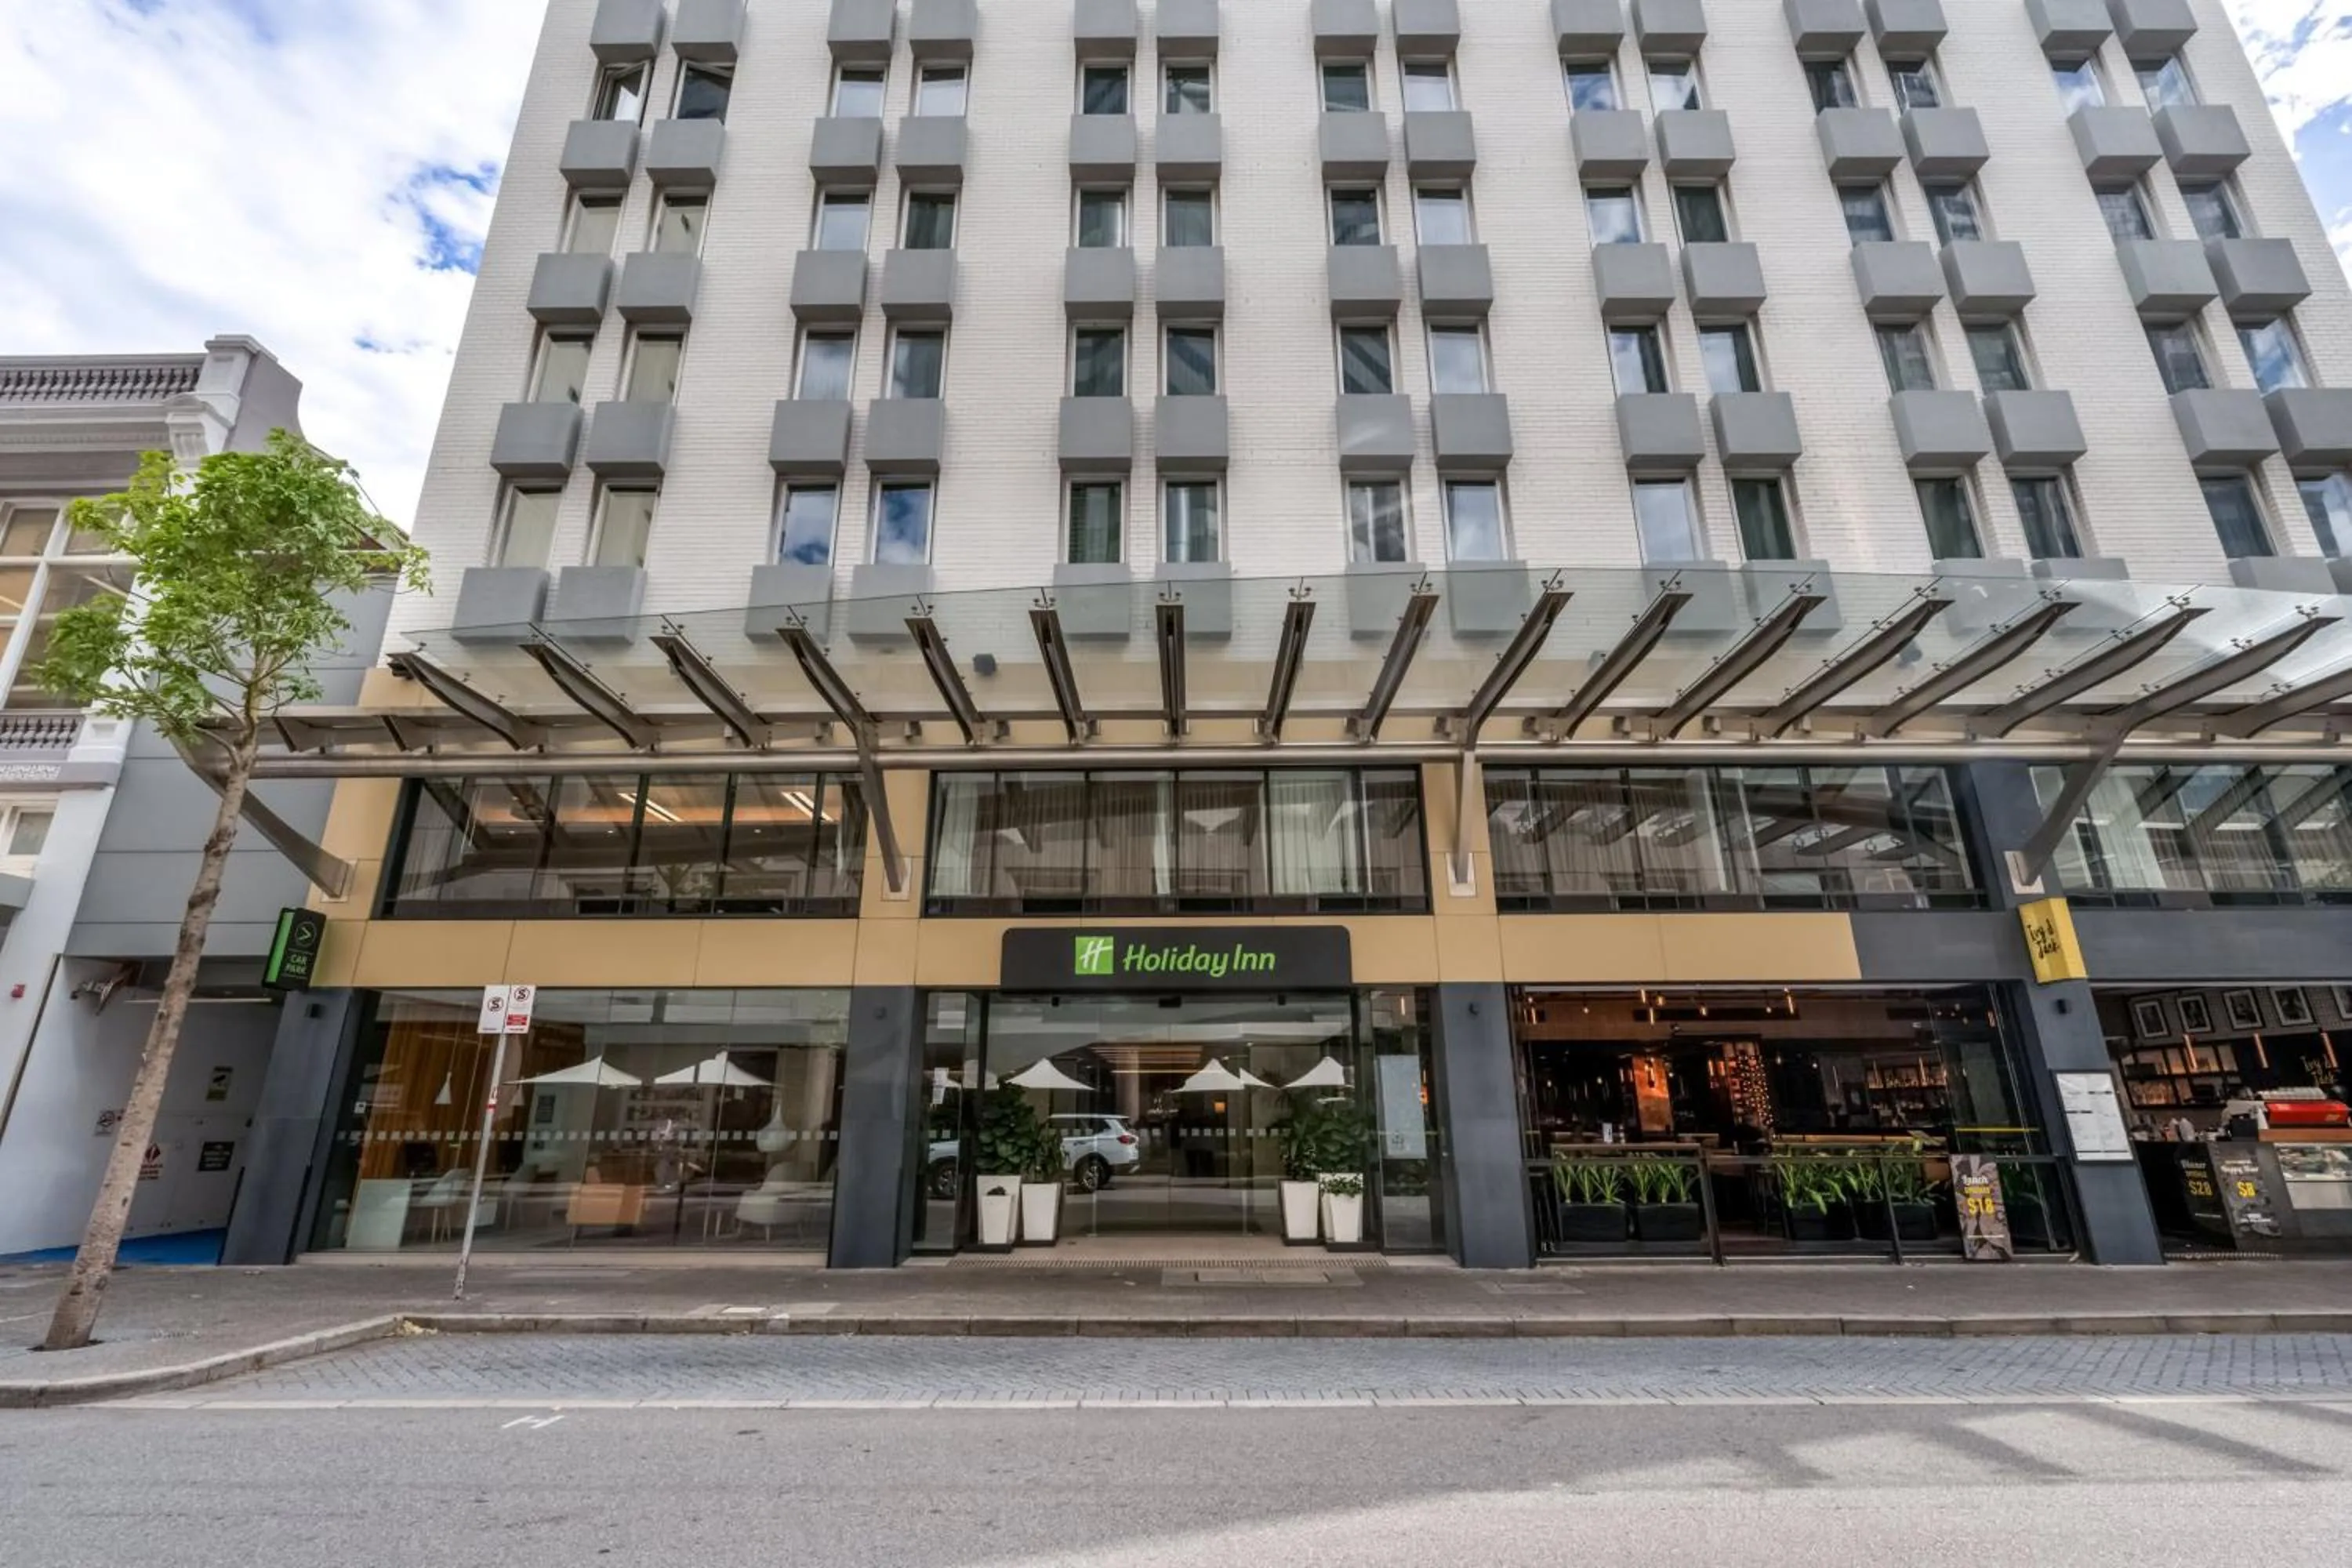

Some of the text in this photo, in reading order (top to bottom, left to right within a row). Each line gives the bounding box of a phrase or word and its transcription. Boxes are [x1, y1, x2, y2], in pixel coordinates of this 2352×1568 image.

[290, 954, 308, 965] CAR
[1123, 943, 1276, 978] Holiday Inn
[284, 963, 308, 975] PARK
